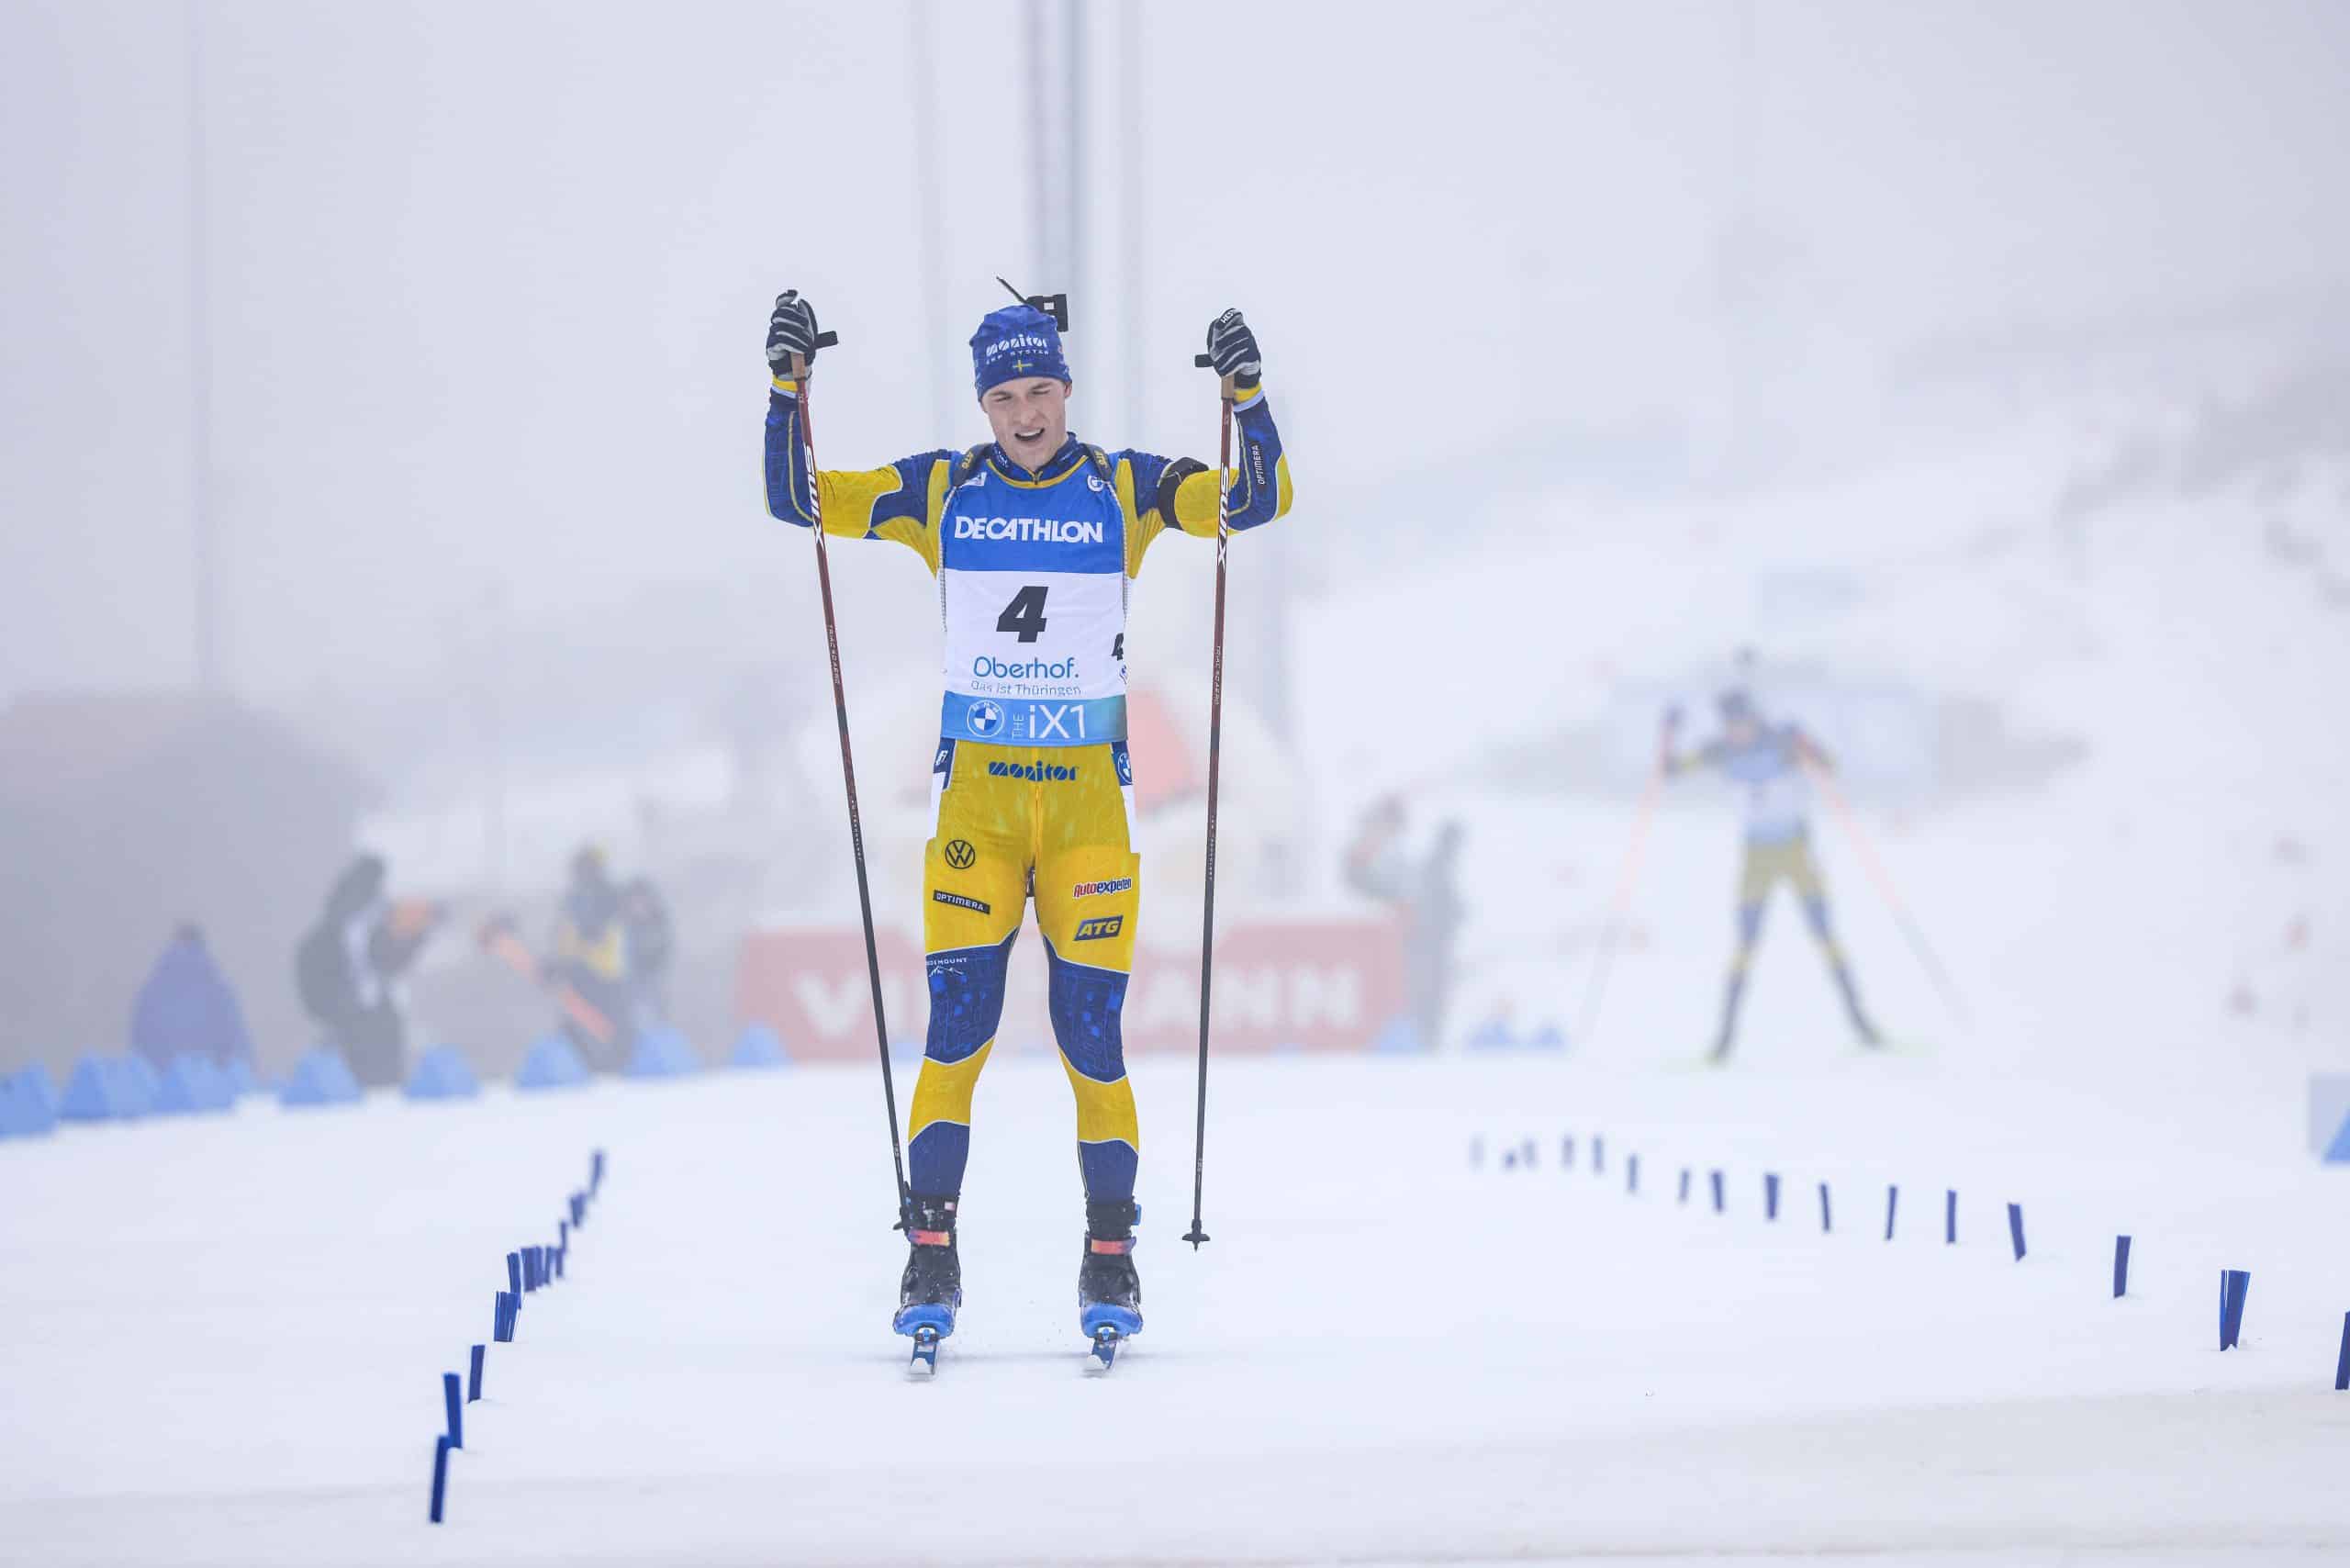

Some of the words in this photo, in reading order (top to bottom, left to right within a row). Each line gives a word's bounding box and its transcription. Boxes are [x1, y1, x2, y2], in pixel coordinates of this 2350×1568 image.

[986, 334, 1047, 356] monitor
[1252, 445, 1265, 486] OPTIMERA
[1217, 463, 1229, 572] SWIX
[954, 516, 1103, 544] DECATHLON
[996, 586, 1049, 644] 4
[973, 656, 1080, 678] Oberhof.
[996, 682, 1011, 694] ist
[1015, 683, 1081, 697] Thüringen
[1012, 714, 1024, 739] THE
[1028, 704, 1086, 739] iX1
[989, 761, 1077, 782] monitor
[935, 892, 984, 911] OPTIMERA
[1079, 920, 1120, 935] ATG
